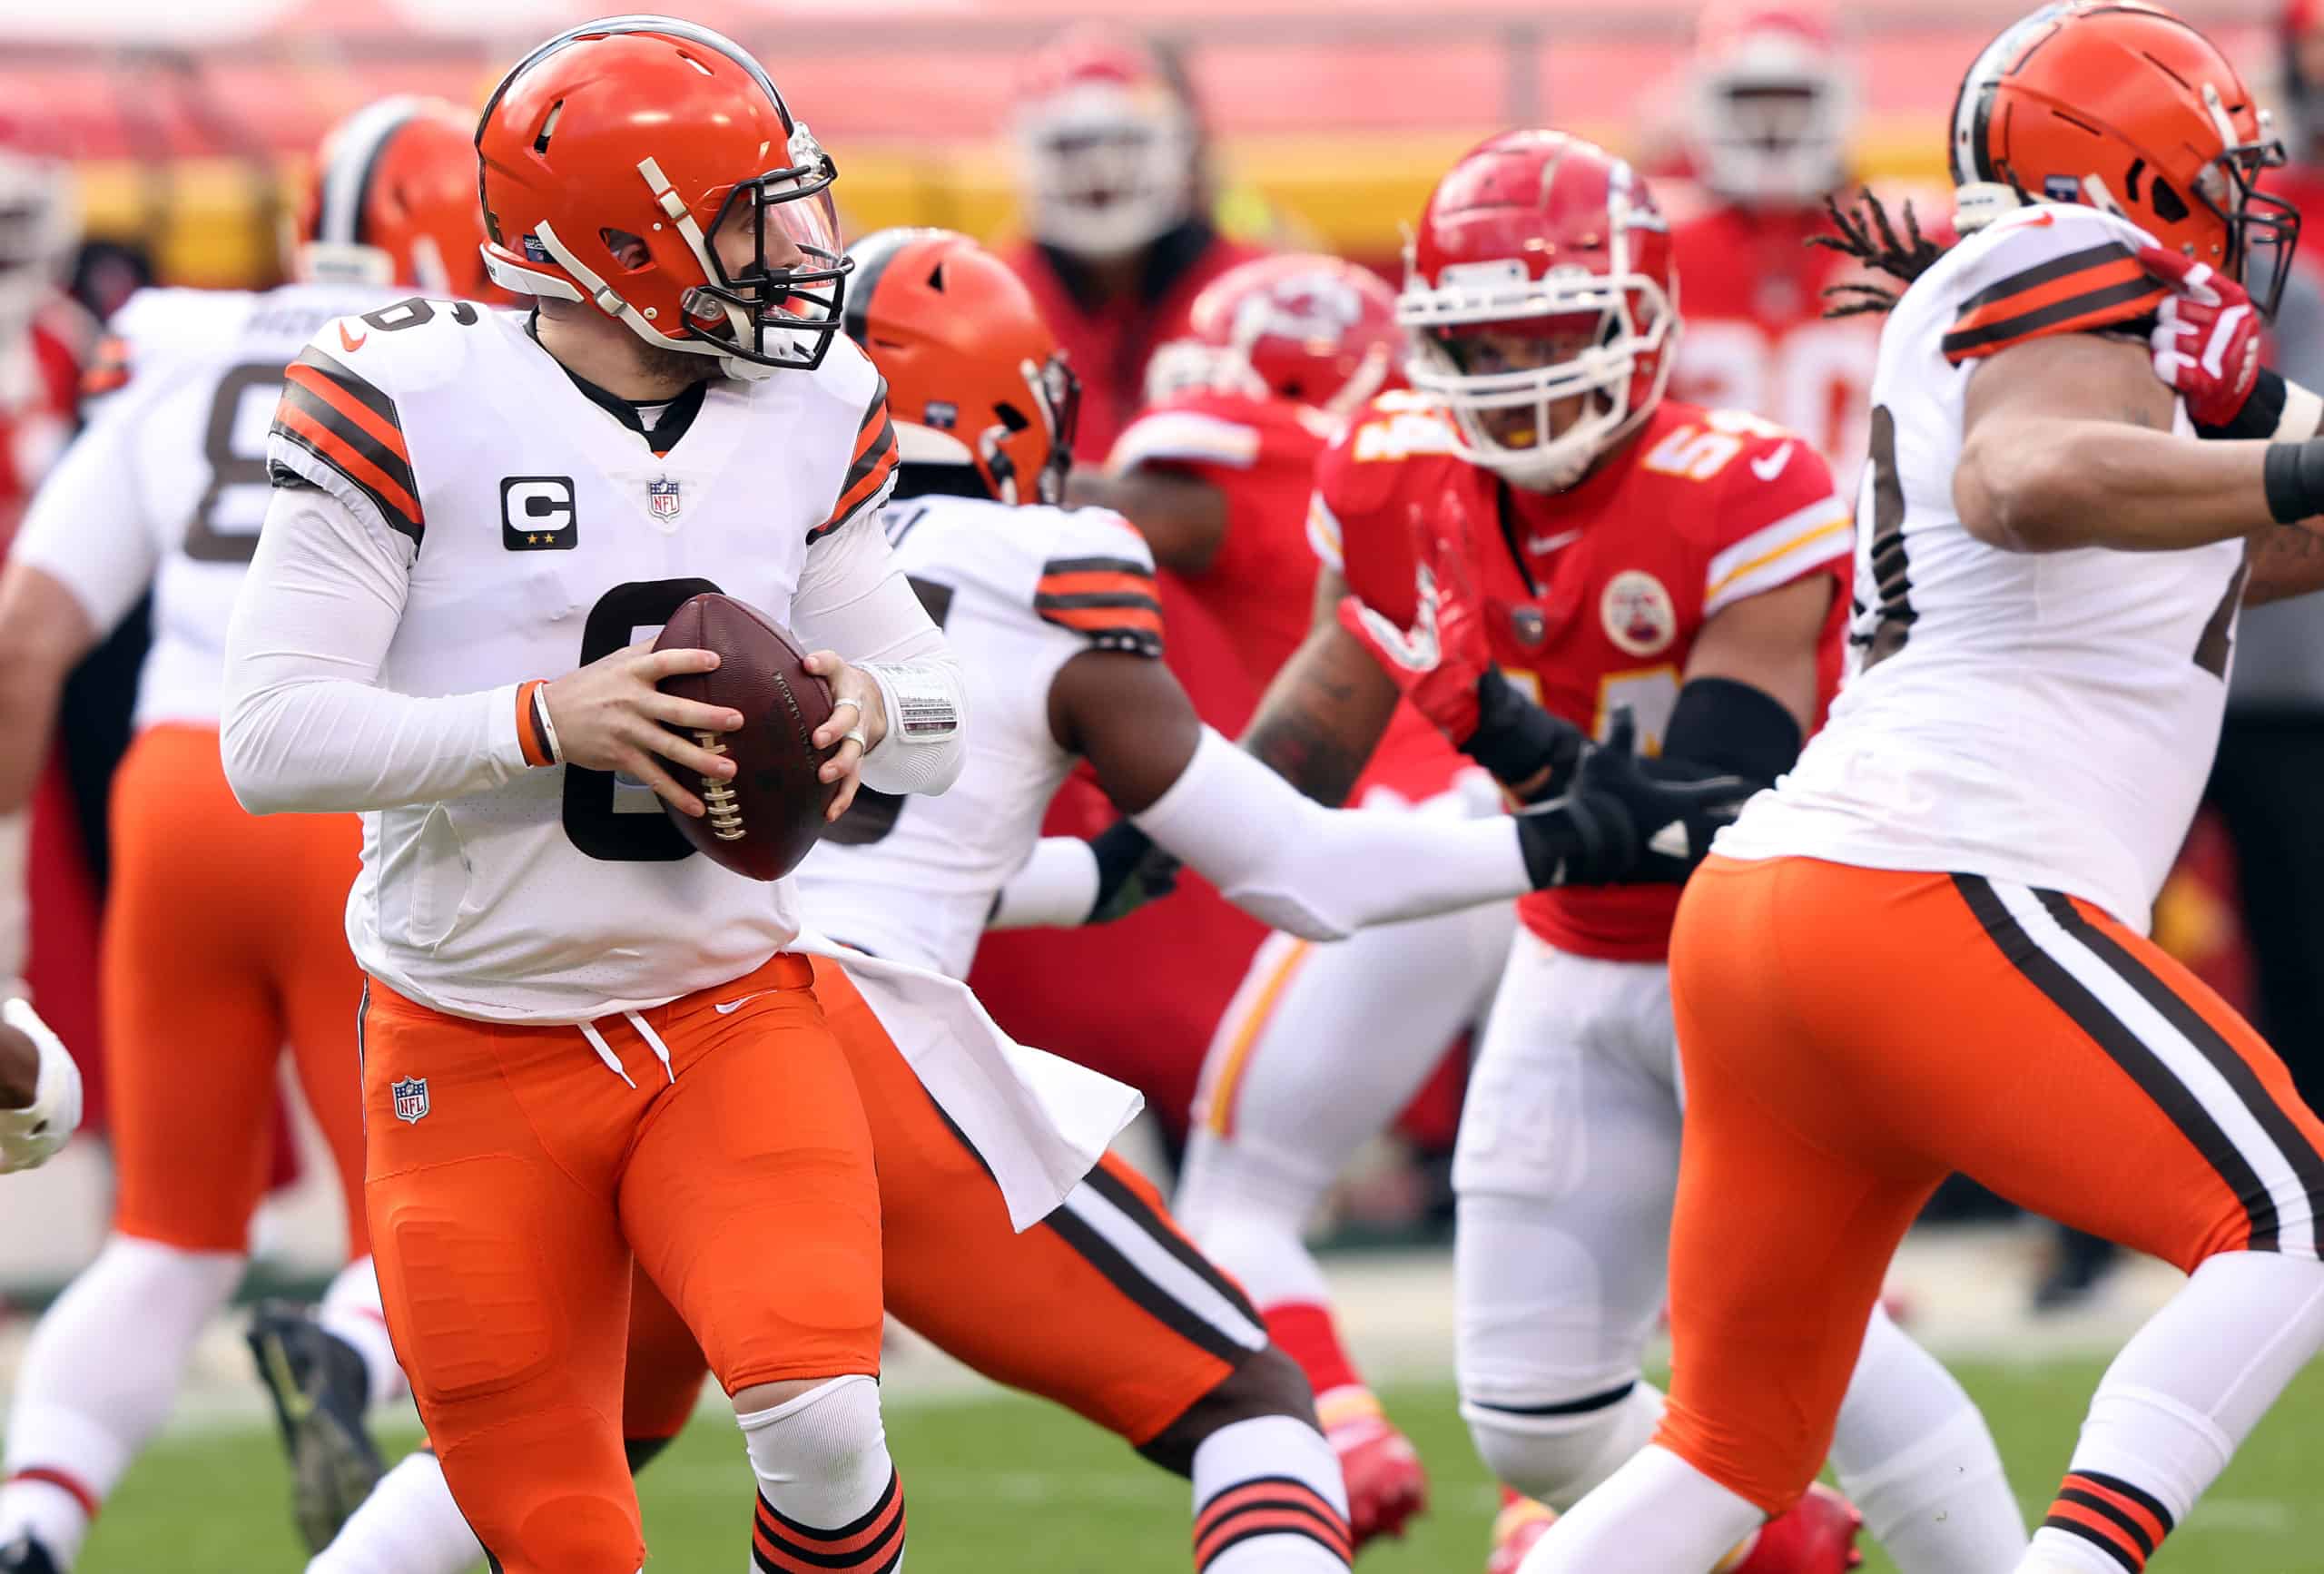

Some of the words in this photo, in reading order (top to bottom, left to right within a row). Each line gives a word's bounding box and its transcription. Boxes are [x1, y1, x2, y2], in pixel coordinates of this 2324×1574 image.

[507, 481, 572, 532] C
[653, 495, 678, 513] NFL
[399, 1096, 424, 1116] NFL
